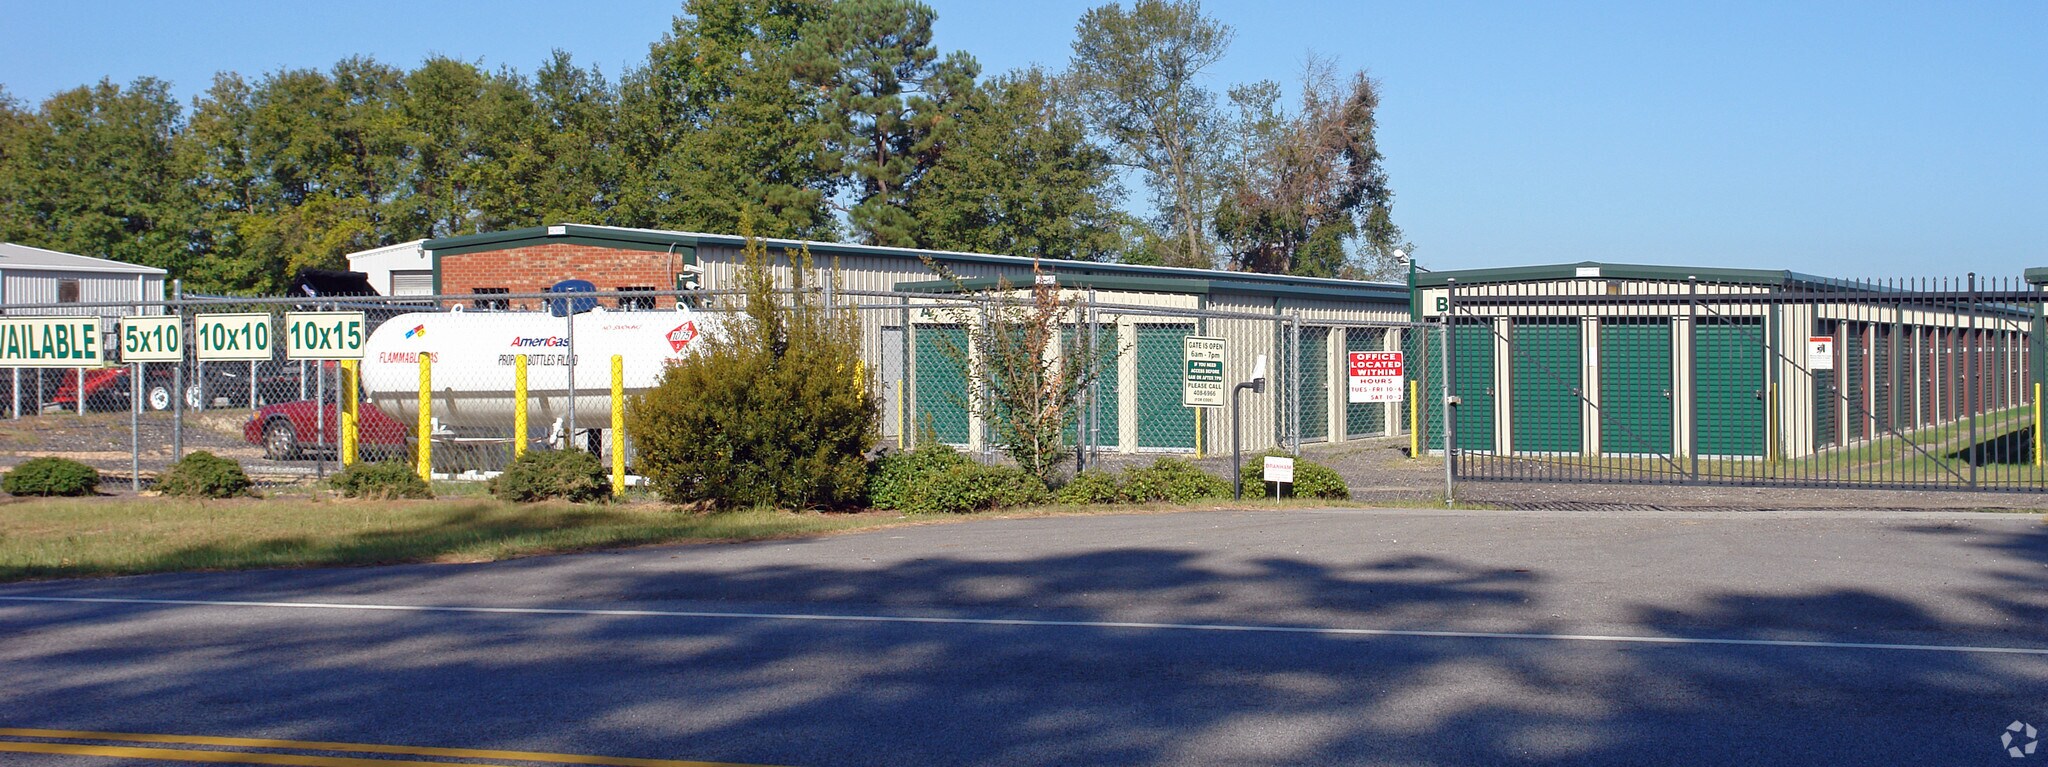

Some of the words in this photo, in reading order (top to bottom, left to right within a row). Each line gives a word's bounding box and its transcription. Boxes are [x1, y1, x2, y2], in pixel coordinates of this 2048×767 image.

[1436, 296, 1449, 312] B
[126, 324, 179, 353] 5x10
[200, 321, 268, 351] 10x10
[290, 320, 361, 350] 10x15
[671, 331, 691, 341] 1075
[510, 336, 569, 347] AmeriGas
[1209, 342, 1223, 350] OPEN
[430, 351, 439, 363] AS
[498, 354, 517, 366] PROP
[528, 354, 555, 366] BOTTLES
[557, 354, 578, 366] FILLD
[1208, 351, 1220, 360] 7pm
